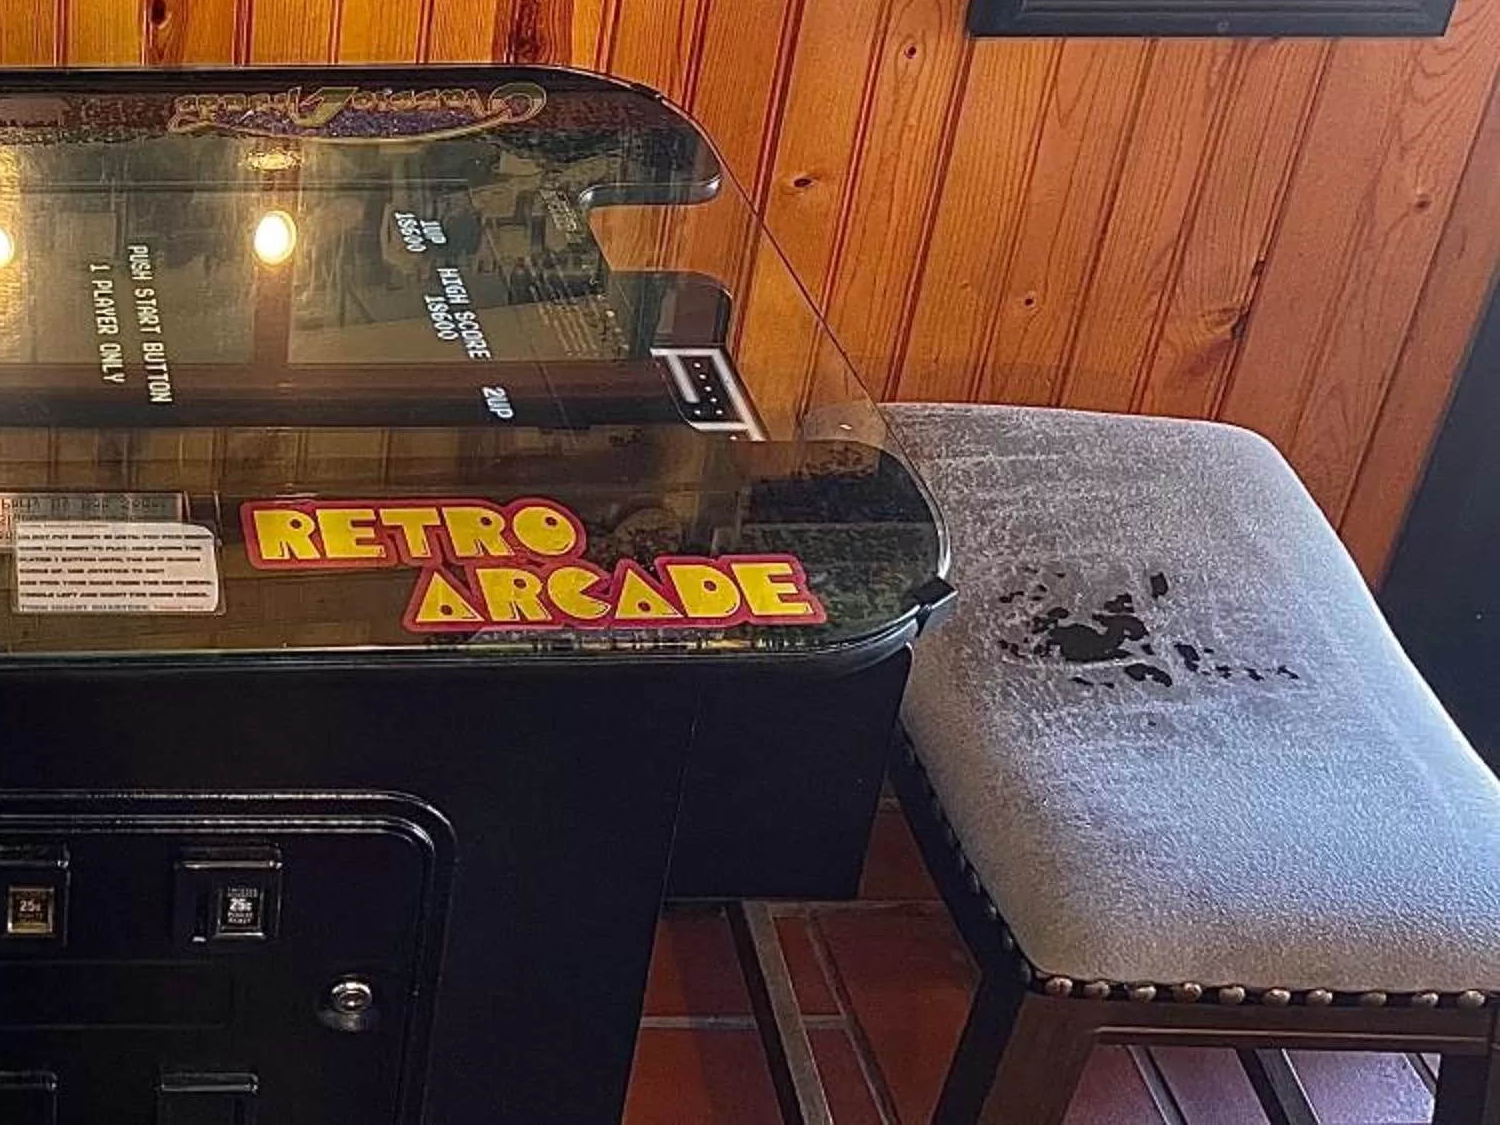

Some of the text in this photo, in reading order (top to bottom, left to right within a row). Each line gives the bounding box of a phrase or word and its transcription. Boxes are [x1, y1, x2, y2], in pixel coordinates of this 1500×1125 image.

[89, 263, 126, 384] 1 PLAYER ONLY
[128, 245, 173, 403] PUSH START BUTTON
[419, 219, 515, 419] 1UP HIGH SCORE 2UP
[248, 504, 580, 563] RETRO
[412, 561, 816, 625] ARCADE
